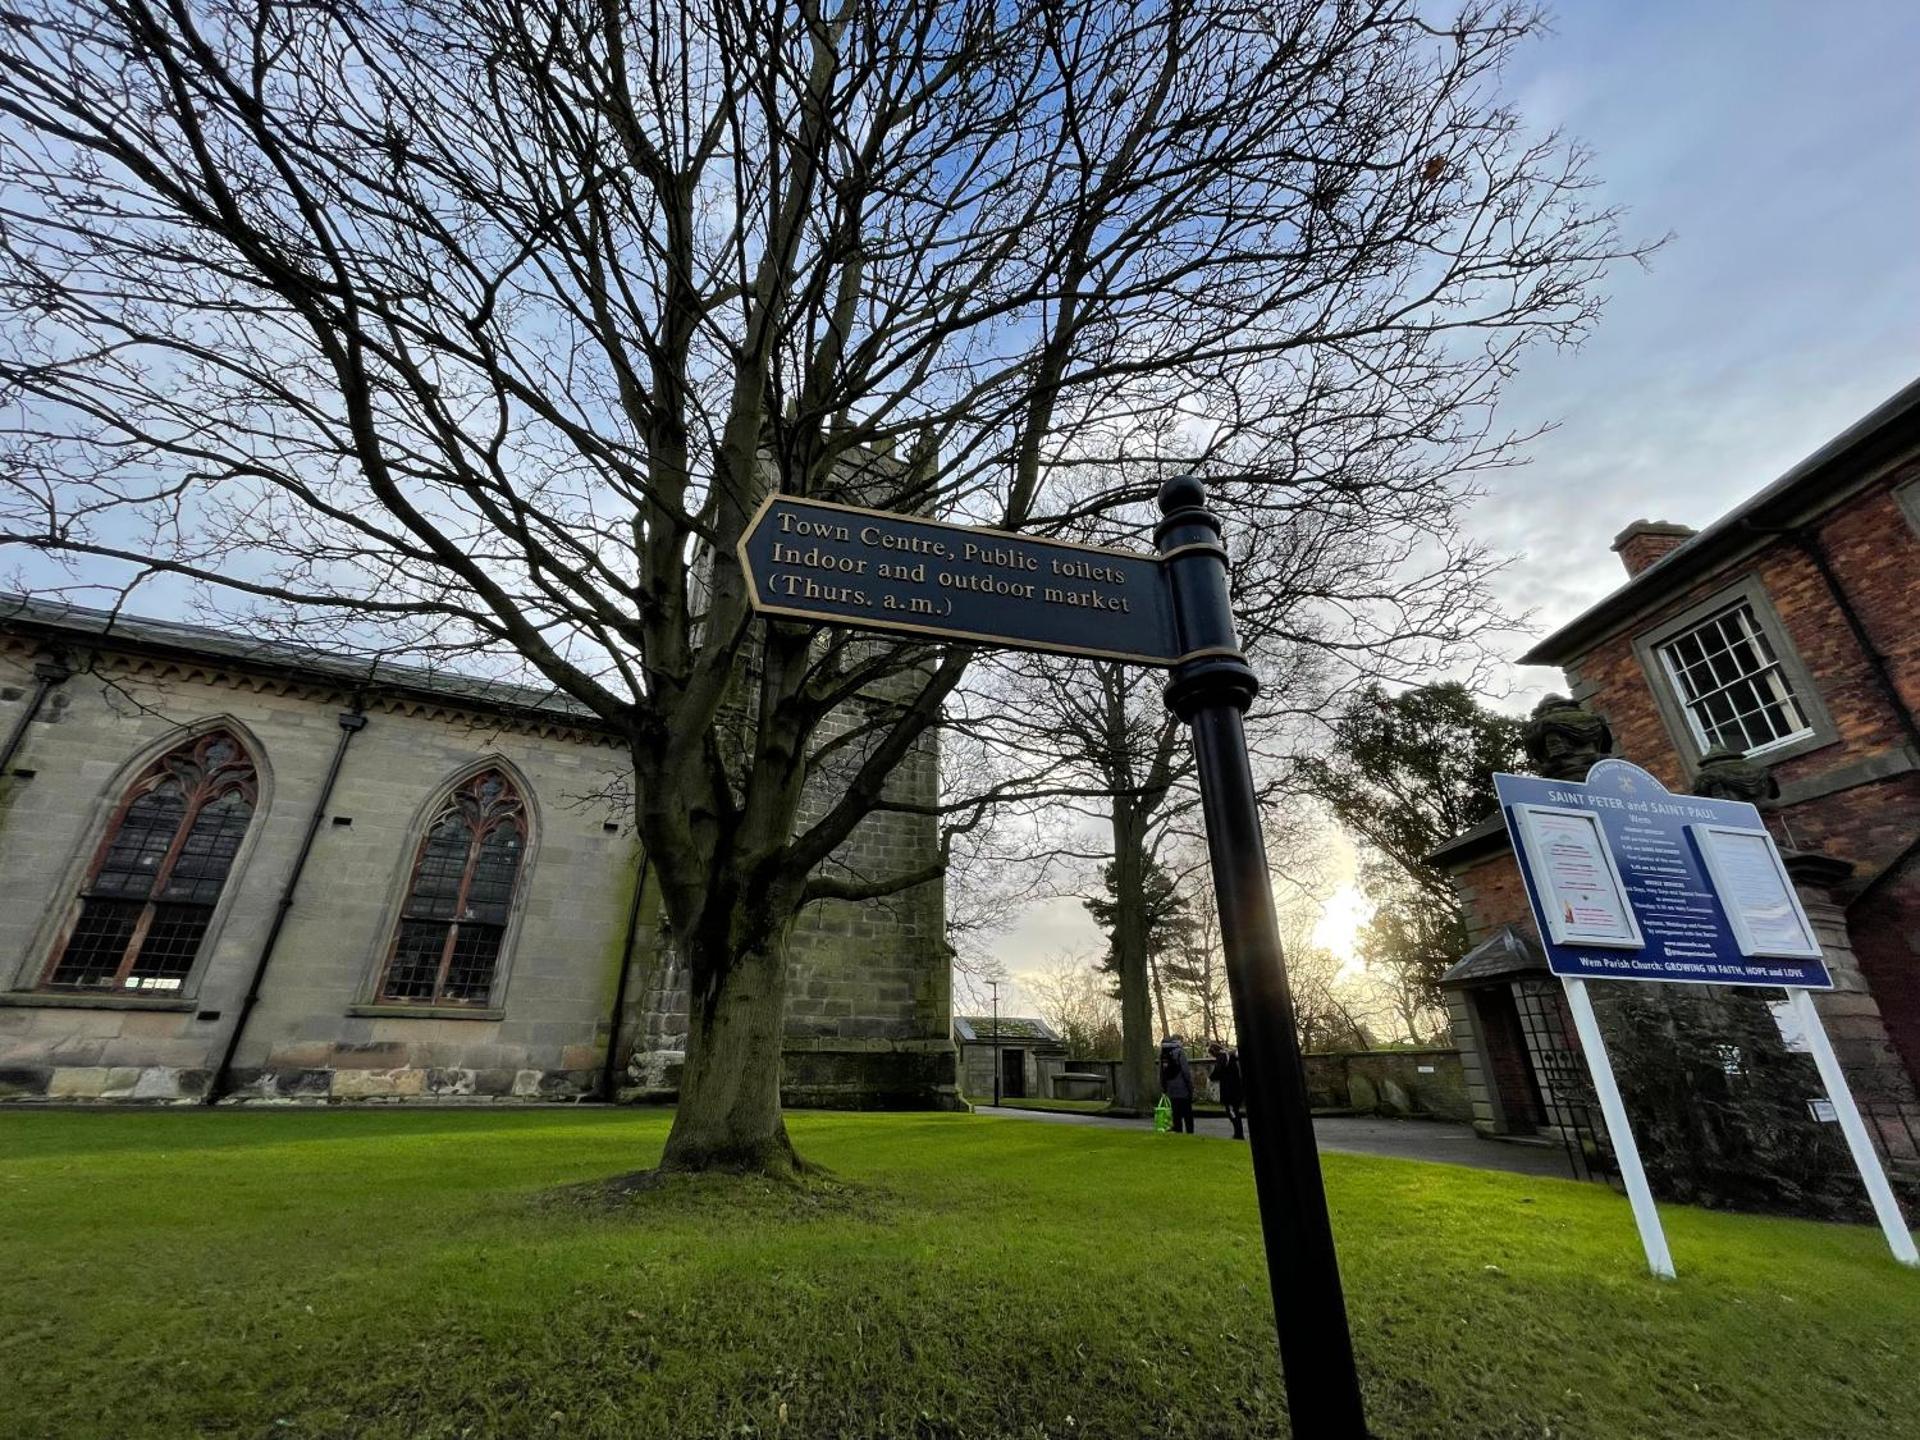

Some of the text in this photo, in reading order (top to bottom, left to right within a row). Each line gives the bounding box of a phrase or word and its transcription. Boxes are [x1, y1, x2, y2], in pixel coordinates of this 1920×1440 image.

[777, 512, 1126, 584] Town Centre, Public toilets
[768, 574, 952, 617] (Thurs. a.m.)
[771, 542, 1131, 613] Indoor and outdoor market
[1547, 790, 1718, 820] SAINT PETER and SAINT PAUL
[1579, 957, 1805, 978] Wem Parish Church: GROWING IN FAITH, HOPE and LOVE
